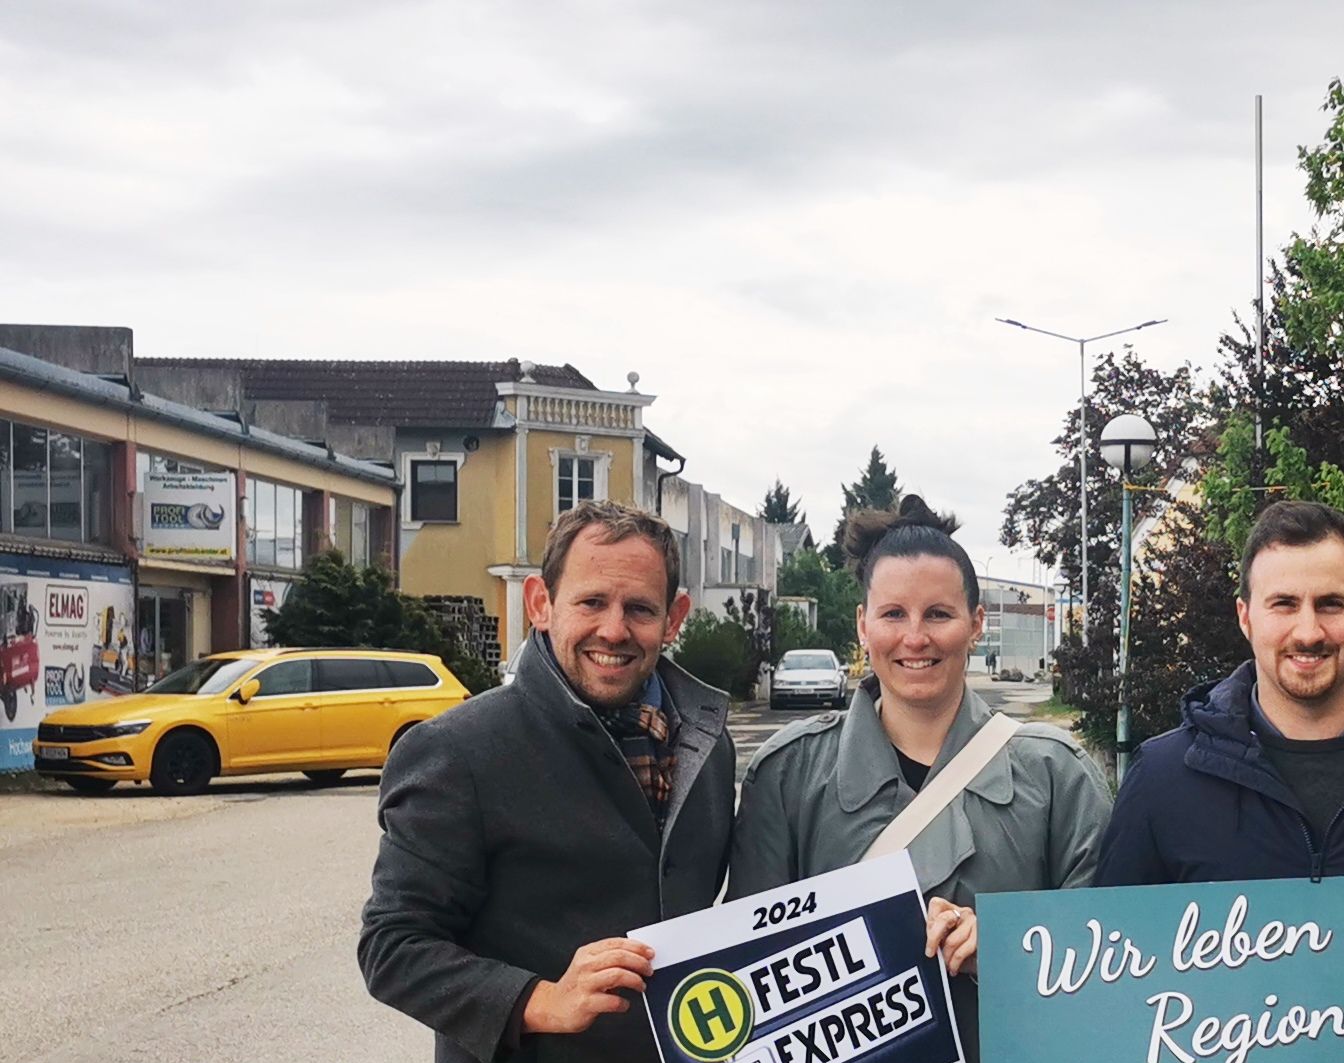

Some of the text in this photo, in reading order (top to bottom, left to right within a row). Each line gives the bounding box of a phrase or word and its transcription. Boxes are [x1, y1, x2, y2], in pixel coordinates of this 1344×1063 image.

[153, 505, 185, 515] PROFI
[153, 514, 184, 523] TOOL
[49, 592, 84, 619] ELMAG
[46, 669, 64, 683] PROFI
[46, 682, 63, 696] TOOL
[752, 891, 818, 931] 2024
[1022, 894, 1332, 997] Wir leben
[750, 933, 865, 1013] FESTL
[687, 986, 736, 1045] H
